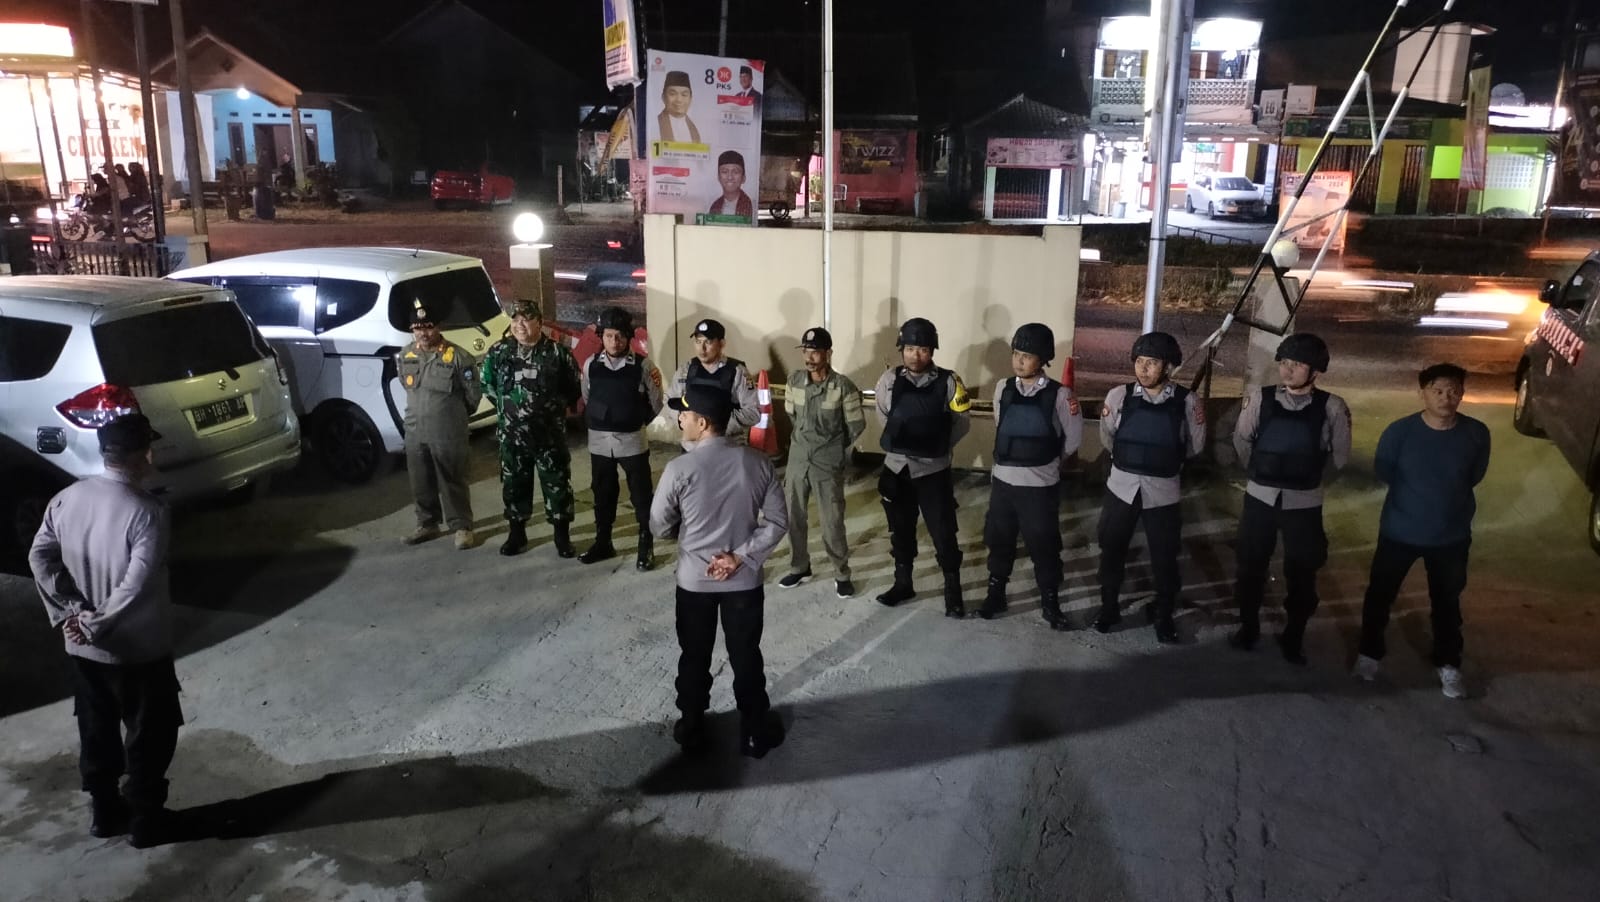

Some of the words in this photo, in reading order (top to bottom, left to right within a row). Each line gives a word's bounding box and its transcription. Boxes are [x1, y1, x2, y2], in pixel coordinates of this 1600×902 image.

[705, 68, 714, 85] 8
[716, 83, 732, 91] PKS
[653, 142, 660, 157] 1
